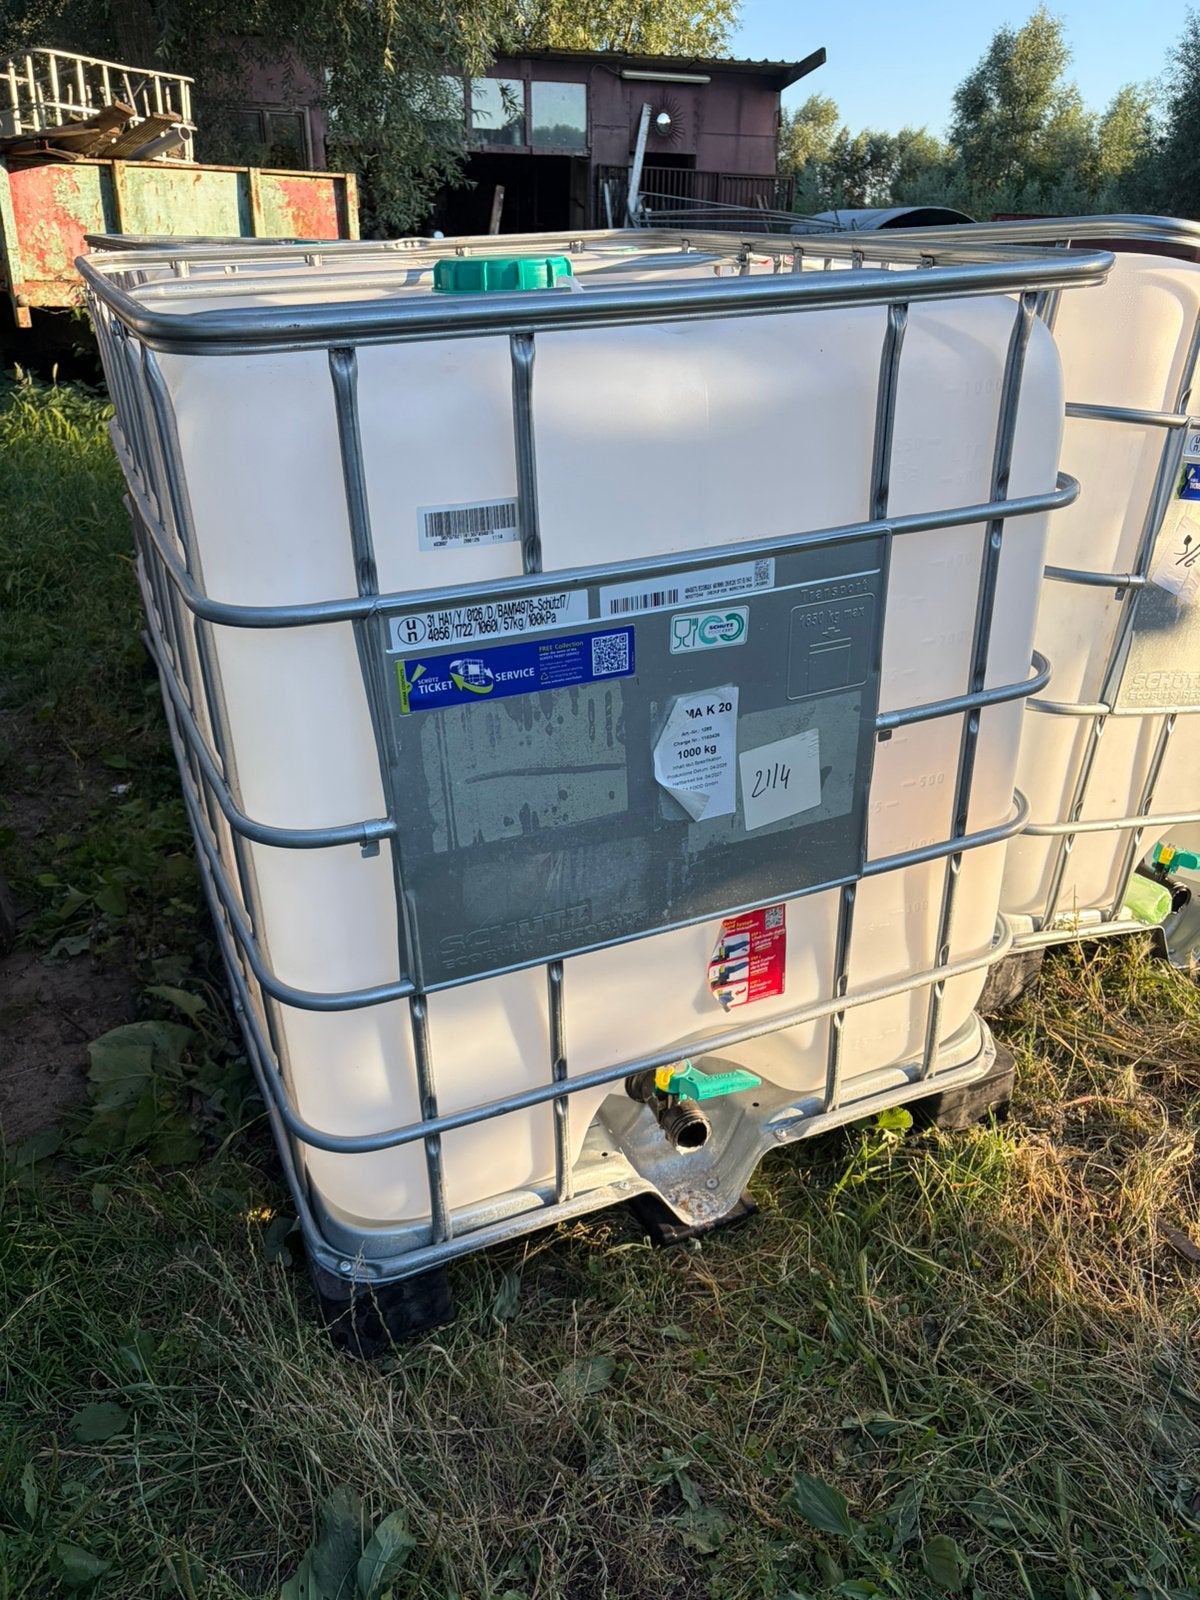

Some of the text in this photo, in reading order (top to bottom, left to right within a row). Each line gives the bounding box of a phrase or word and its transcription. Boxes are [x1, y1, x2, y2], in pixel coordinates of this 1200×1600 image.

[418, 680, 453, 695] TICKET
[495, 667, 535, 682] SERVICE
[706, 703, 716, 716] K
[718, 702, 732, 713] 20
[677, 744, 717, 760] 1000 kg
[919, 772, 945, 788] 500
